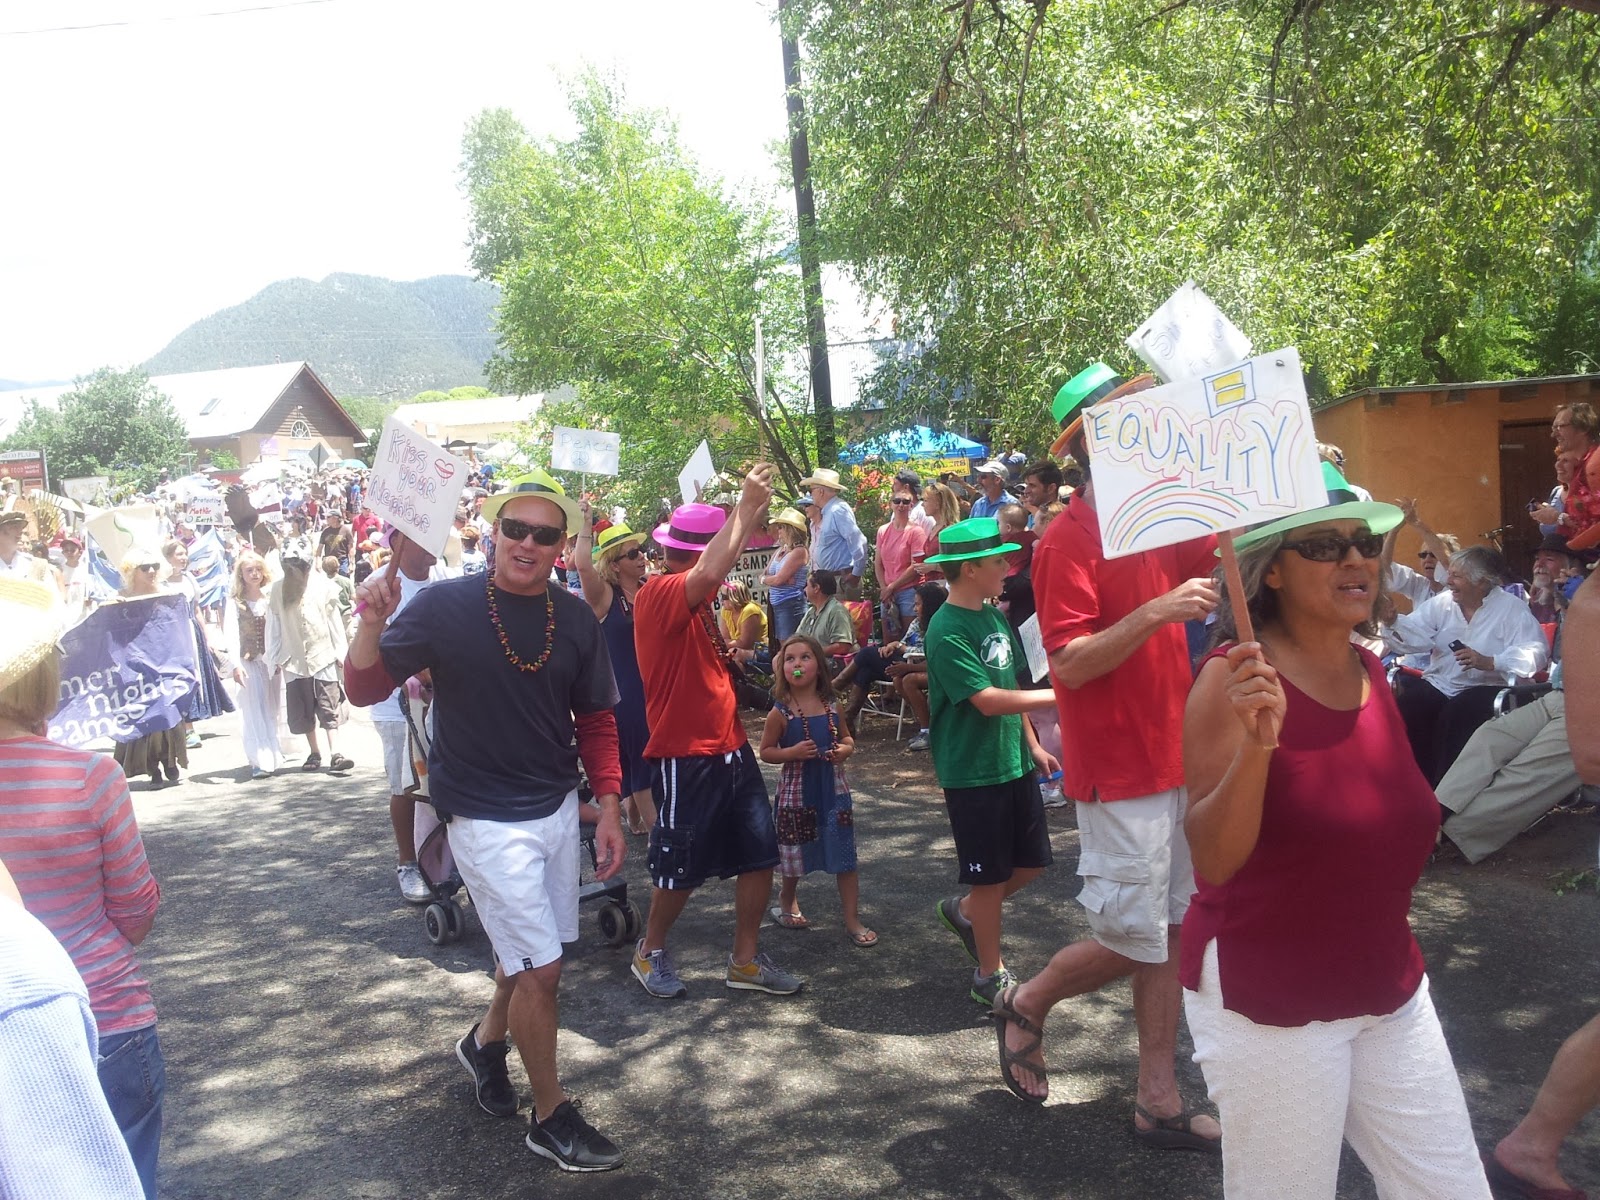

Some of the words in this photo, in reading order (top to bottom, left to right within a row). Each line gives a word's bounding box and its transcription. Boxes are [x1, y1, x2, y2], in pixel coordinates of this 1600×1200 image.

[388, 428, 427, 473] Kiss
[1094, 410, 1287, 499] EQUALITY
[189, 507, 212, 515] Mother
